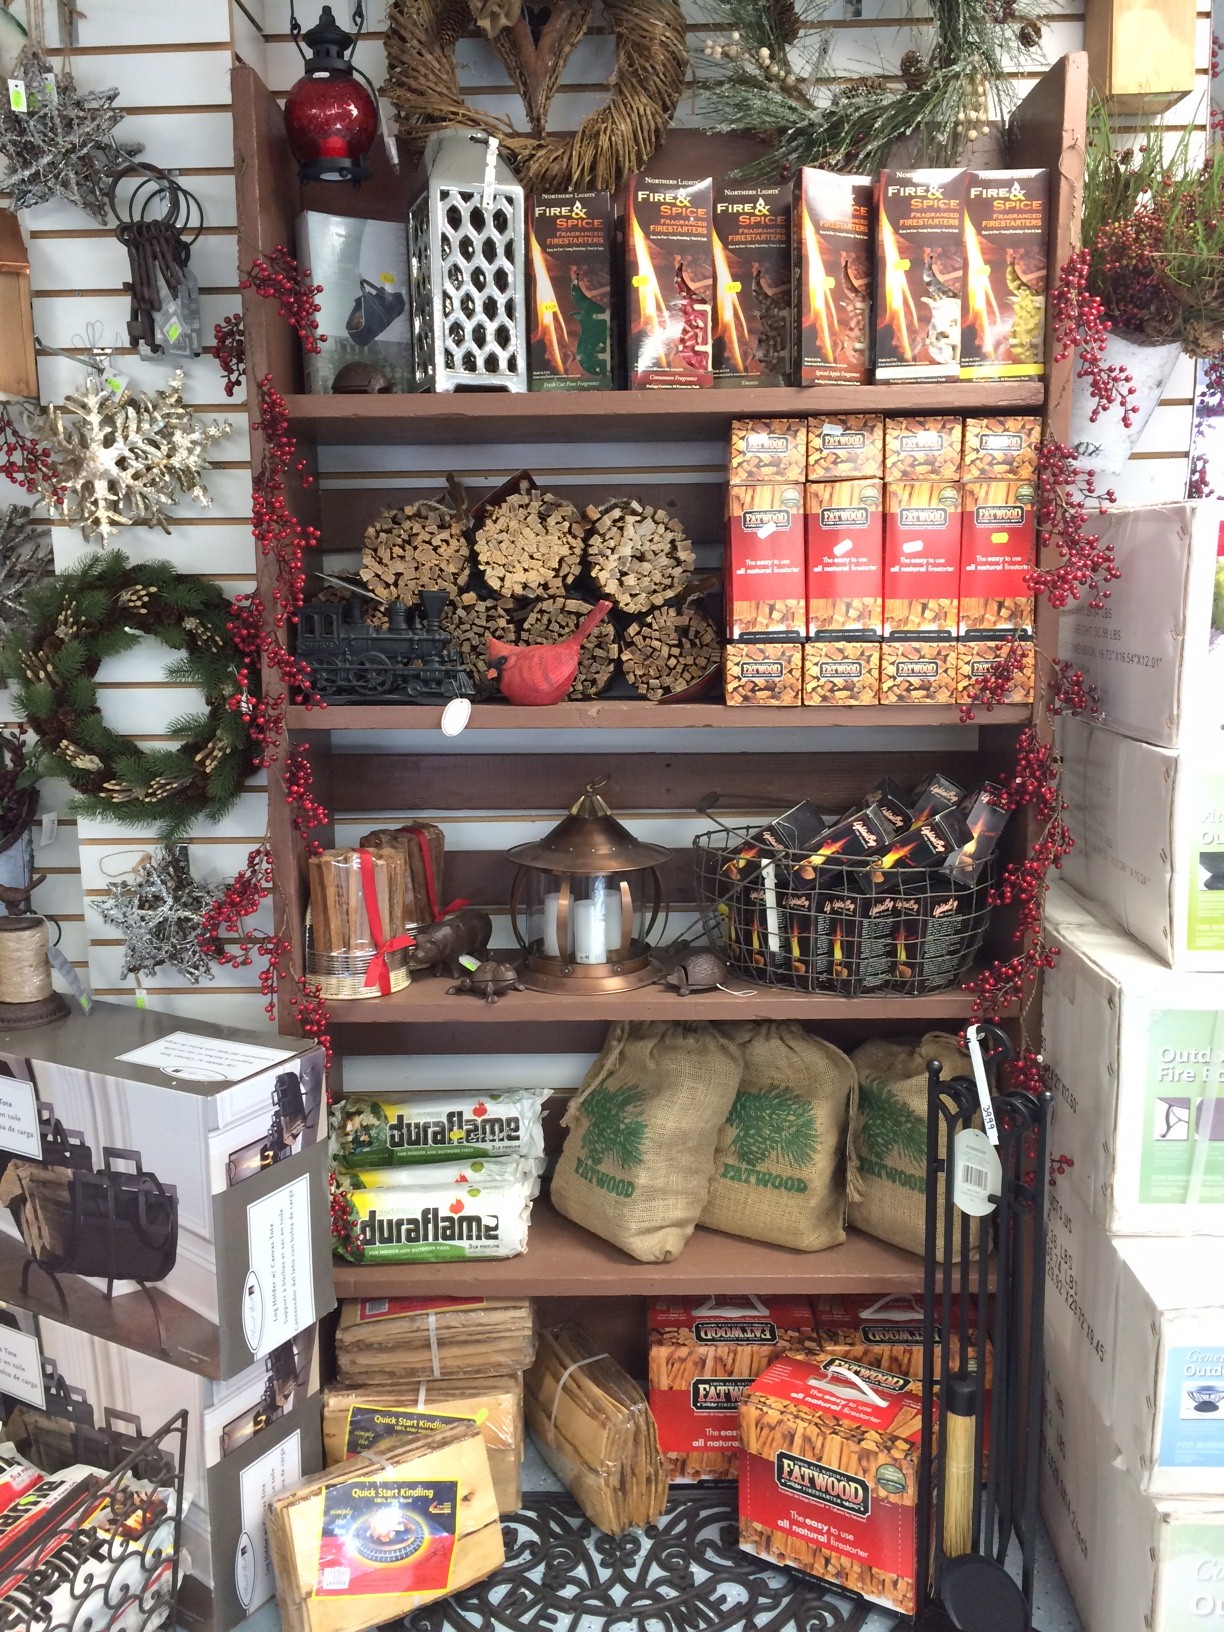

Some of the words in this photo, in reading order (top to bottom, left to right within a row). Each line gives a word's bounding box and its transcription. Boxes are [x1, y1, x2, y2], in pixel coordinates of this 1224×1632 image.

[645, 177, 677, 185] NORTHERN
[911, 199, 960, 209] SPICE
[993, 200, 1043, 211] SPICE
[660, 205, 707, 218] SPICE
[556, 218, 604, 228] SPICE
[661, 218, 707, 227] FRAGRANCED
[738, 215, 786, 225] SPICE
[899, 218, 960, 226] FIRESTARTERS
[981, 219, 1042, 228] FIRESTARTERS
[650, 225, 708, 235] FIRESTARTERS
[819, 220, 869, 233] FIRESTARTERS
[546, 237, 604, 245] FIRESTARTERS
[728, 234, 786, 242] FIRESTARTERS
[825, 435, 864, 446] FATWOOD
[745, 513, 788, 525] FATWOOD
[823, 510, 867, 522] FATWOOD
[902, 511, 945, 522] FATWOOD
[979, 509, 1022, 521] FATWOOD
[756, 559, 772, 567] easy
[911, 557, 928, 565] easy
[736, 567, 746, 575] all
[824, 564, 850, 572] natural
[977, 563, 1003, 571] natural
[743, 665, 781, 674] FATWOOD
[822, 665, 861, 674] FATWOOD
[898, 664, 937, 673] FATWOOD
[1158, 1066, 1196, 1083] Fire
[8, 1114, 22, 1122] toile
[983, 1105, 996, 1131] 39.99
[17, 1129, 34, 1139] carga
[388, 1111, 521, 1149] duraflame
[575, 1156, 636, 1199] FATWOOD
[720, 1162, 808, 1194] FATWOOD
[289, 1211, 294, 1221] de
[359, 1207, 499, 1247] duraflame
[291, 1289, 299, 1332] Contenedor
[700, 1326, 772, 1340] FATWOOD
[4, 1347, 17, 1358] Tote
[12, 1364, 26, 1372] toile
[830, 1359, 905, 1388] FATWOOD
[22, 1378, 38, 1389] carga
[809, 1389, 822, 1397] The
[823, 1393, 849, 1406] easy
[849, 1401, 857, 1409] to
[858, 1405, 873, 1413] use
[789, 1391, 804, 1400] all
[805, 1396, 842, 1412] natural
[843, 1407, 882, 1425] firestarter
[374, 1414, 396, 1425] Quick
[398, 1418, 417, 1427] Start
[354, 1430, 376, 1440] simply
[705, 1428, 719, 1437] The
[692, 1438, 705, 1447] all
[795, 1460, 809, 1469] 100%
[810, 1465, 821, 1473] ALL
[822, 1469, 848, 1481] NATURAL
[782, 1458, 863, 1504] FATWOOD
[352, 1487, 376, 1498] Quick
[378, 1487, 398, 1498] Start
[400, 1487, 434, 1499] Kindling
[802, 1486, 841, 1504] FIRESTARTER
[790, 1510, 805, 1523] The
[805, 1517, 829, 1533] easy
[830, 1525, 838, 1535] to
[840, 1531, 855, 1541] use
[777, 1519, 790, 1529] all
[792, 1525, 828, 1543] natural
[830, 1536, 869, 1558] firestarter
